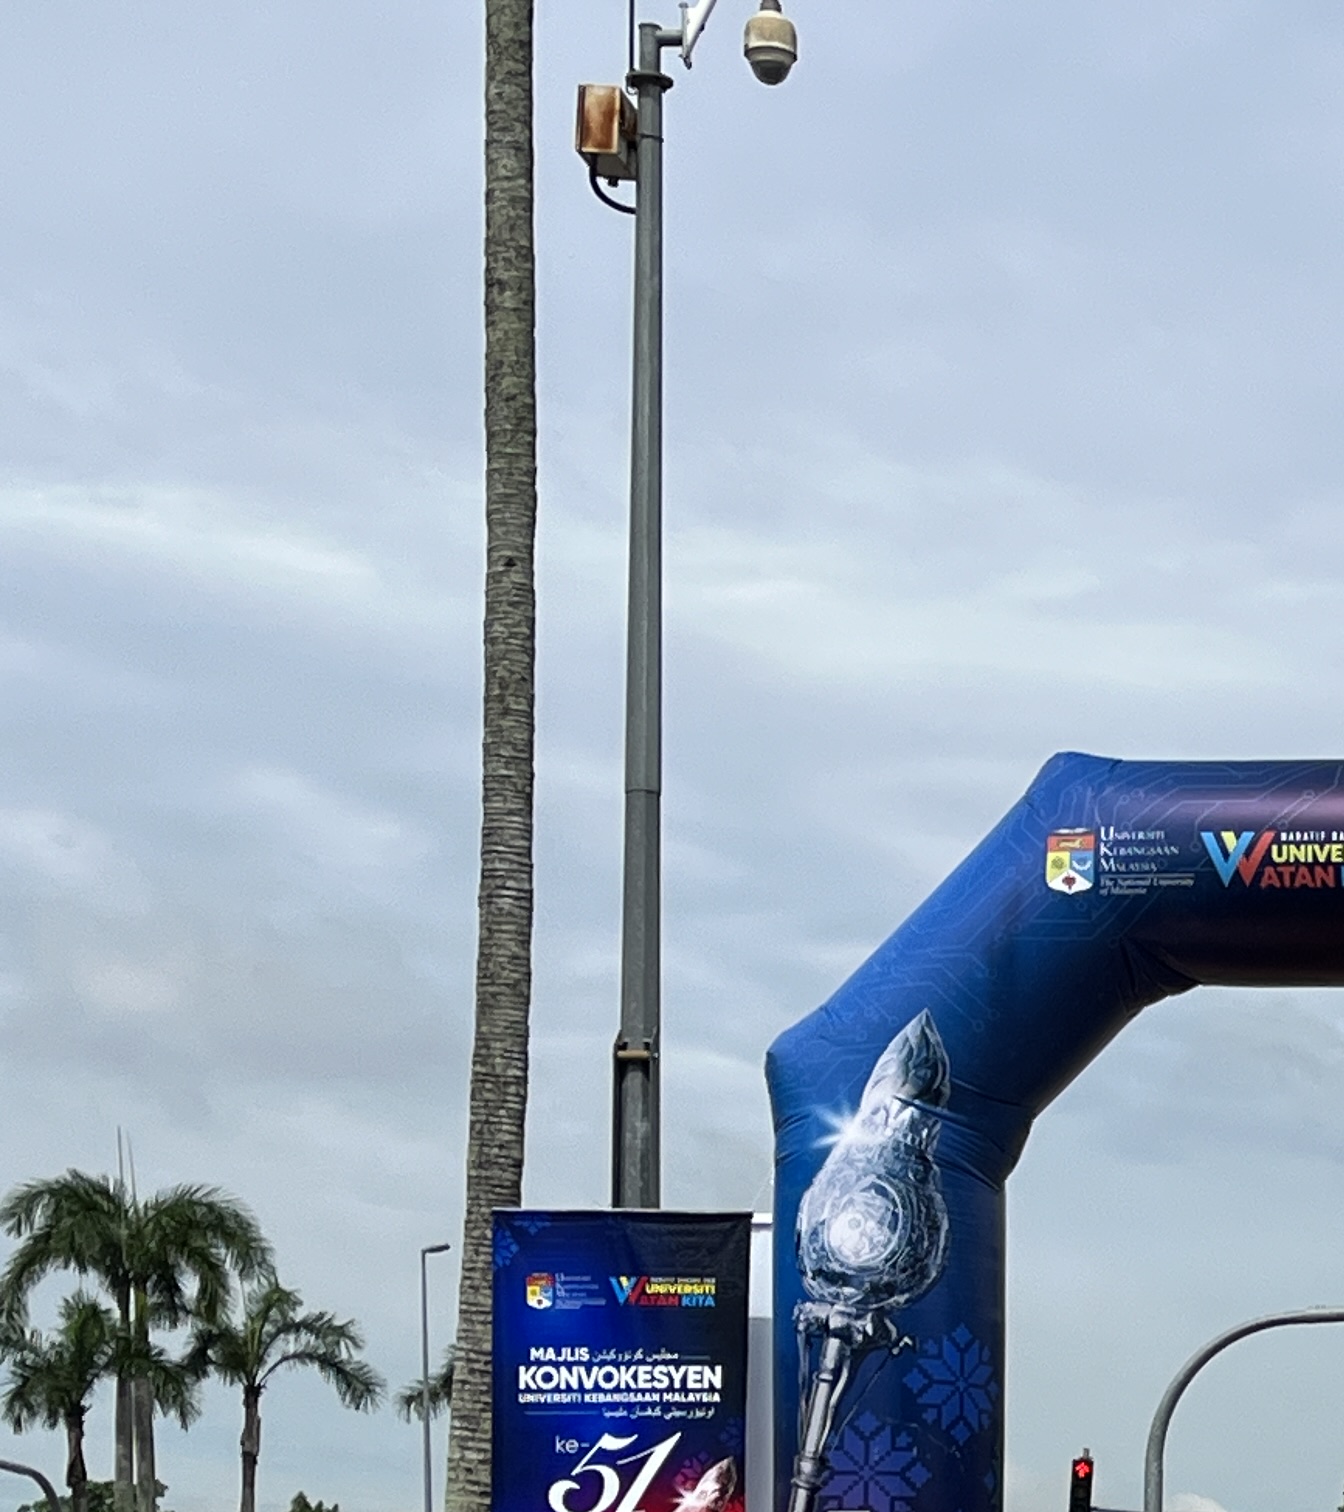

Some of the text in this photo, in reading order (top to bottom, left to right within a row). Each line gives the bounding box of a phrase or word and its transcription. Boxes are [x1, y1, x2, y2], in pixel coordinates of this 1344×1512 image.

[529, 1347, 590, 1362] MAJLIS
[518, 1365, 722, 1390] KONVOKESYEN
[517, 1392, 721, 1404] UNIVERSITI KEBANGSAAN MALAYSIA
